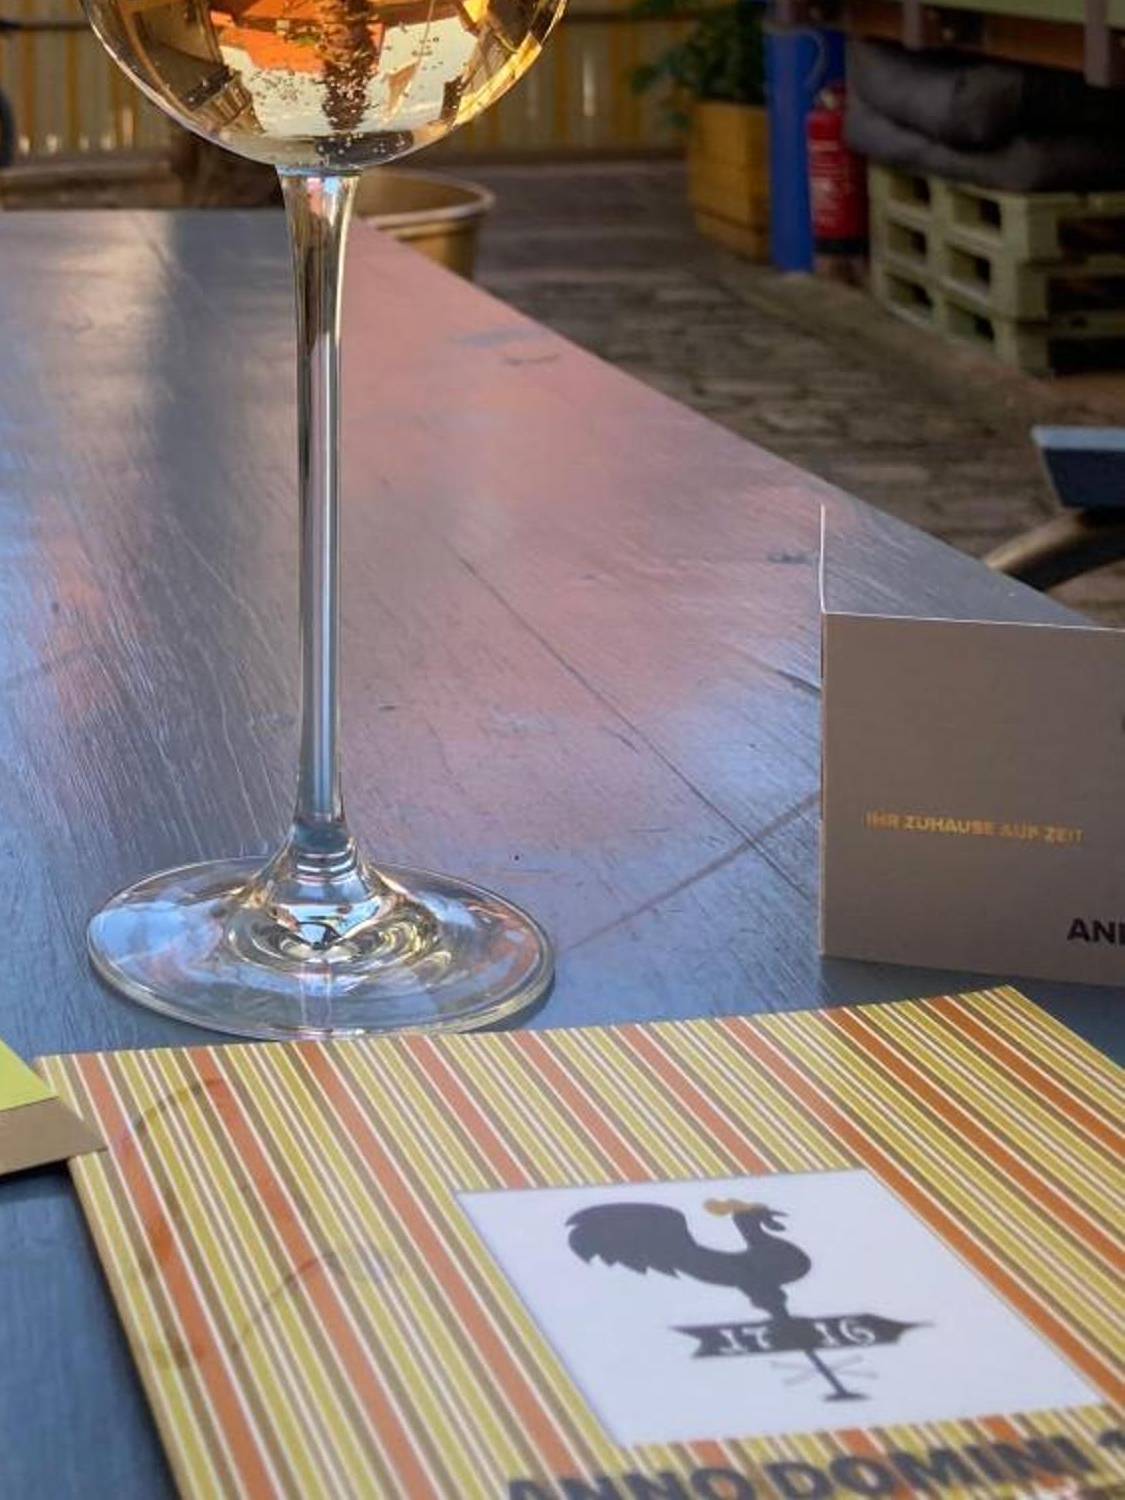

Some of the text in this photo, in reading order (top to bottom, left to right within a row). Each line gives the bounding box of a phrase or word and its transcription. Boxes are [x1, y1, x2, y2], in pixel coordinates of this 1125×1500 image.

[904, 815, 994, 836] ZUHAUSE
[1044, 826, 1084, 843] ZEIT
[718, 1316, 875, 1355] 17 16
[766, 1434, 1096, 1499] DOMINI
